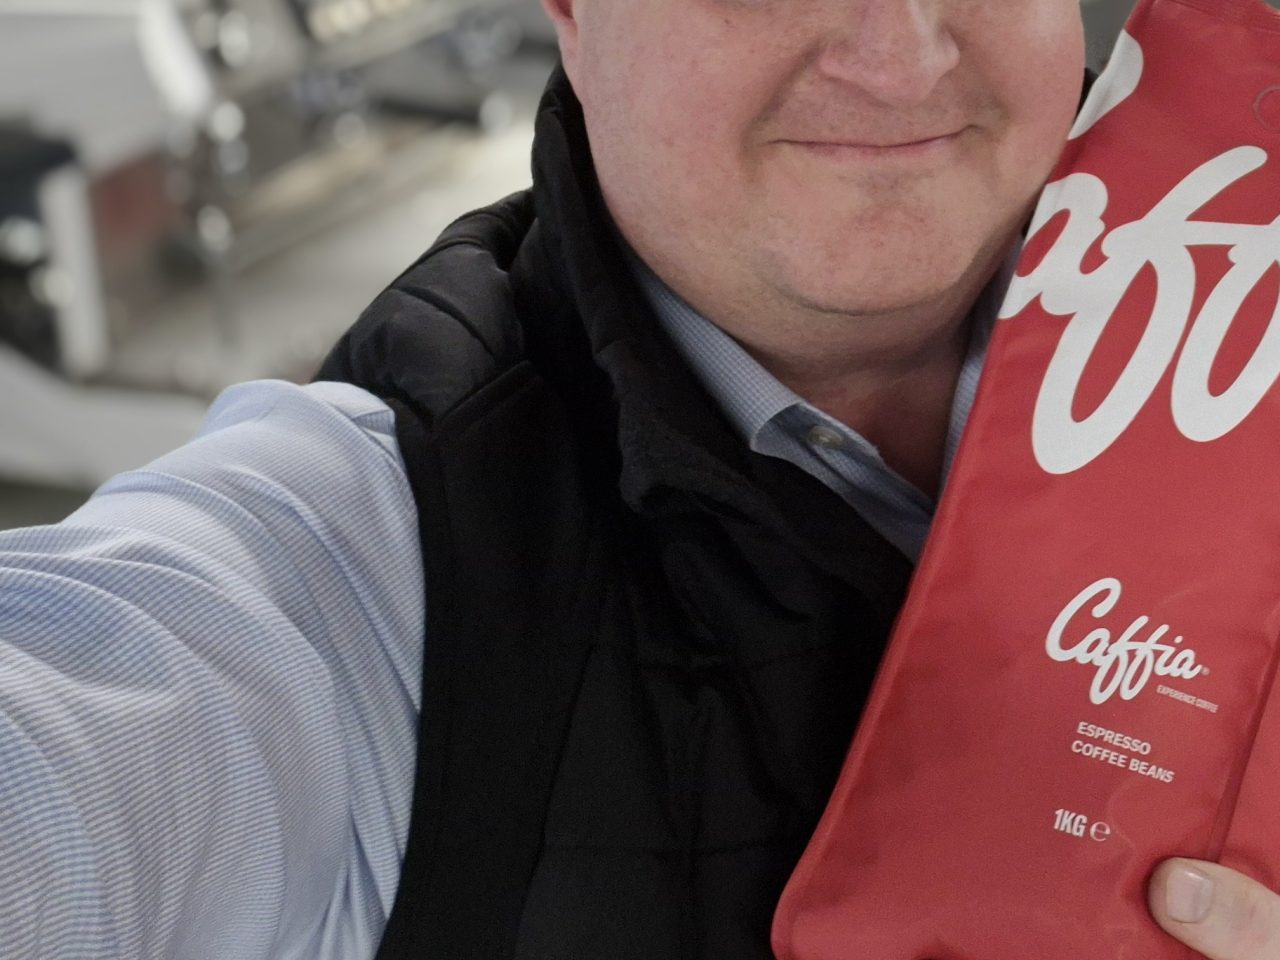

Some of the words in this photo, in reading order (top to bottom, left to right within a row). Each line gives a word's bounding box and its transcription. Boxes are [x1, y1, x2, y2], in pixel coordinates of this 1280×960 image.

[1045, 577, 1203, 705] Caffia
[1076, 721, 1151, 755] ESPRESSO
[1071, 740, 1127, 769] COFFEE
[1128, 758, 1175, 784] BEANS
[1053, 808, 1088, 838] 1KG
